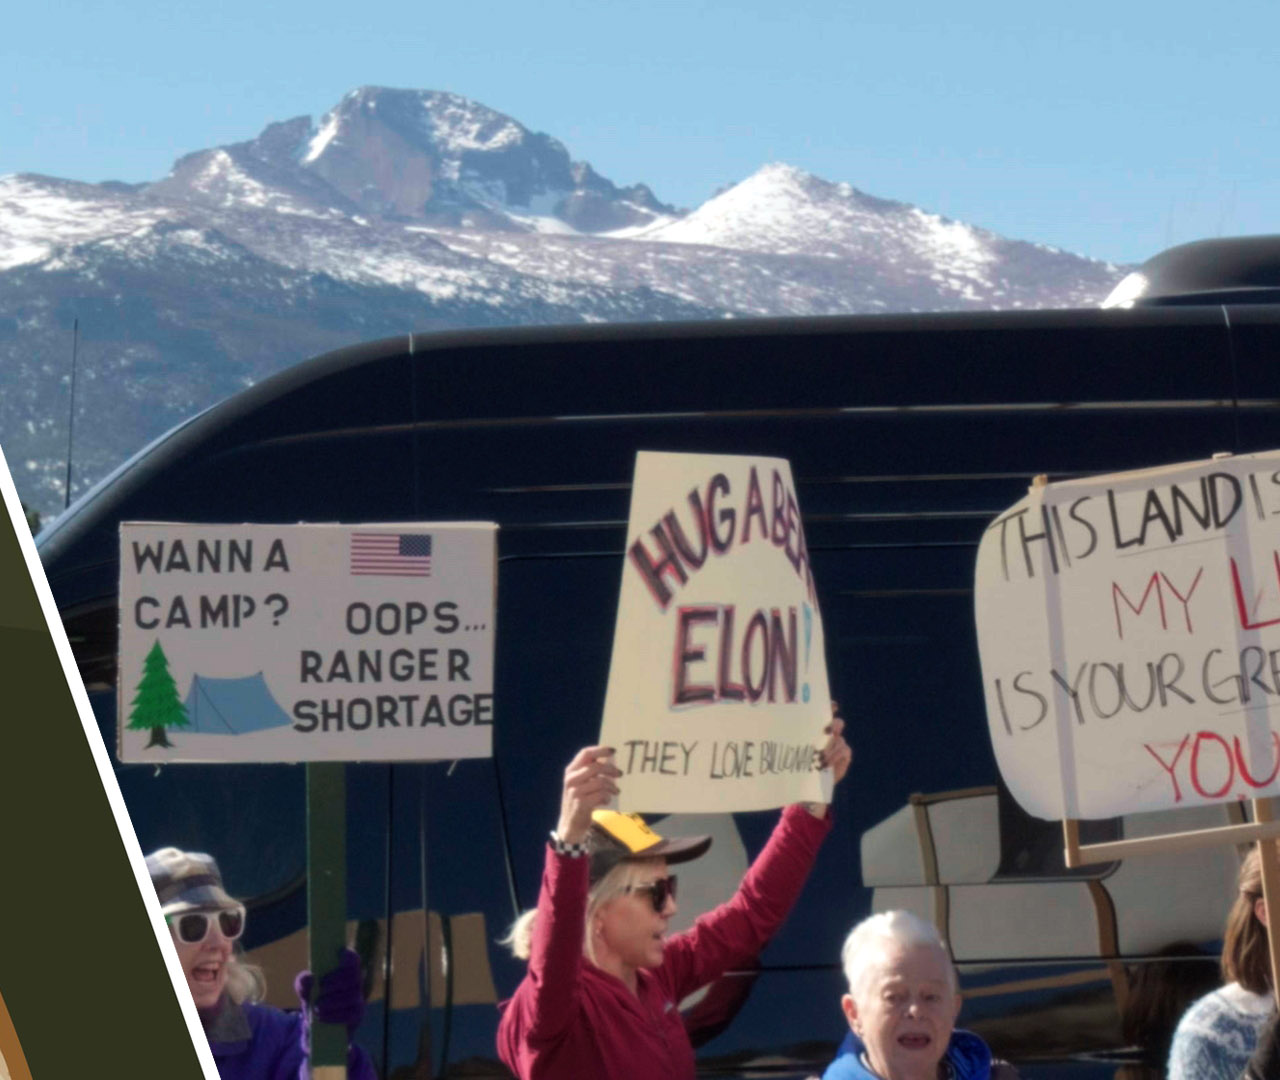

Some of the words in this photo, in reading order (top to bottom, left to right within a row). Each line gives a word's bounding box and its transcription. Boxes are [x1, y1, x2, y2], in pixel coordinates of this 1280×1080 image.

[626, 473, 736, 615] HUG
[740, 465, 768, 545] A
[984, 496, 1098, 581] THIS
[1108, 472, 1243, 549] LAND
[132, 538, 290, 574] WANNA
[132, 592, 290, 631] CAMP?
[345, 601, 488, 636] OOPS...
[1111, 567, 1204, 640] MY
[300, 648, 472, 684] RANGER
[671, 601, 814, 712] ELON!
[292, 692, 494, 733] SHORTAGE
[994, 669, 1048, 735] IS
[1049, 652, 1195, 725] YOUR
[624, 739, 699, 777] THEY
[709, 739, 755, 781] LOVE
